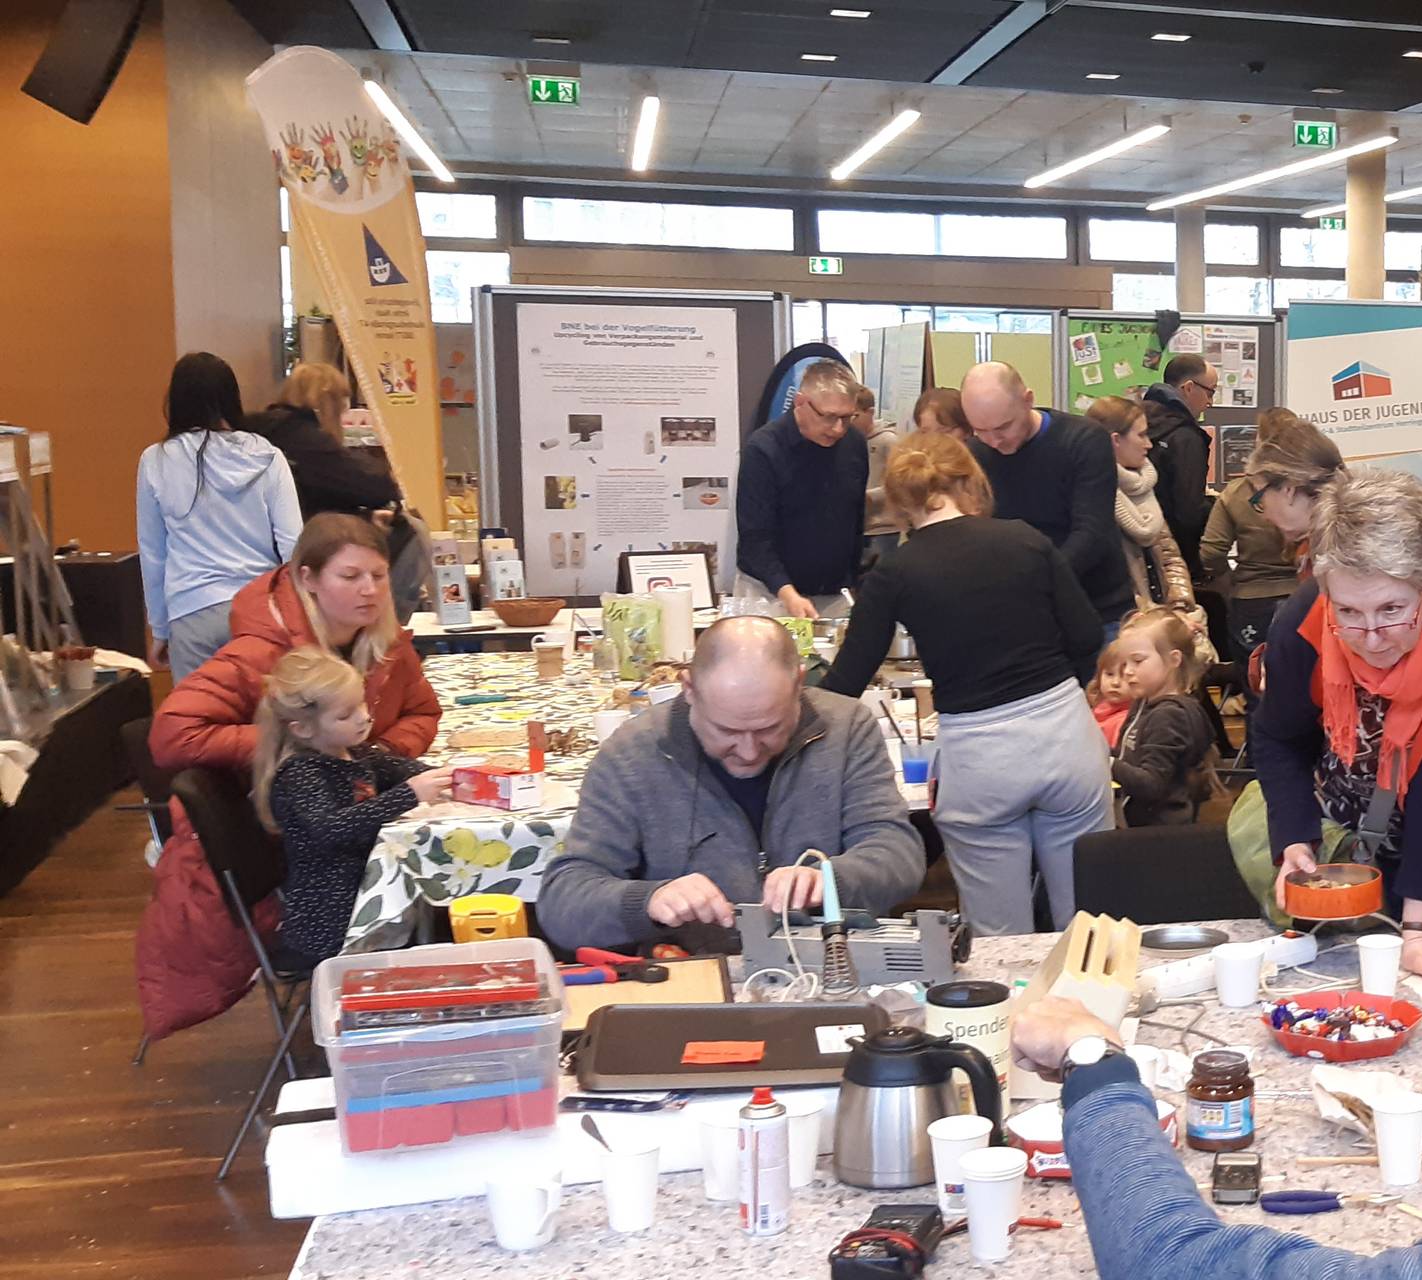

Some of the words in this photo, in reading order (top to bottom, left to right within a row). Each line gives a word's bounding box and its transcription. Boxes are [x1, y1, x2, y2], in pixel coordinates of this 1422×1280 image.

[602, 323, 619, 331] der
[1300, 410, 1338, 424] HAUS
[1343, 407, 1371, 422] DER
